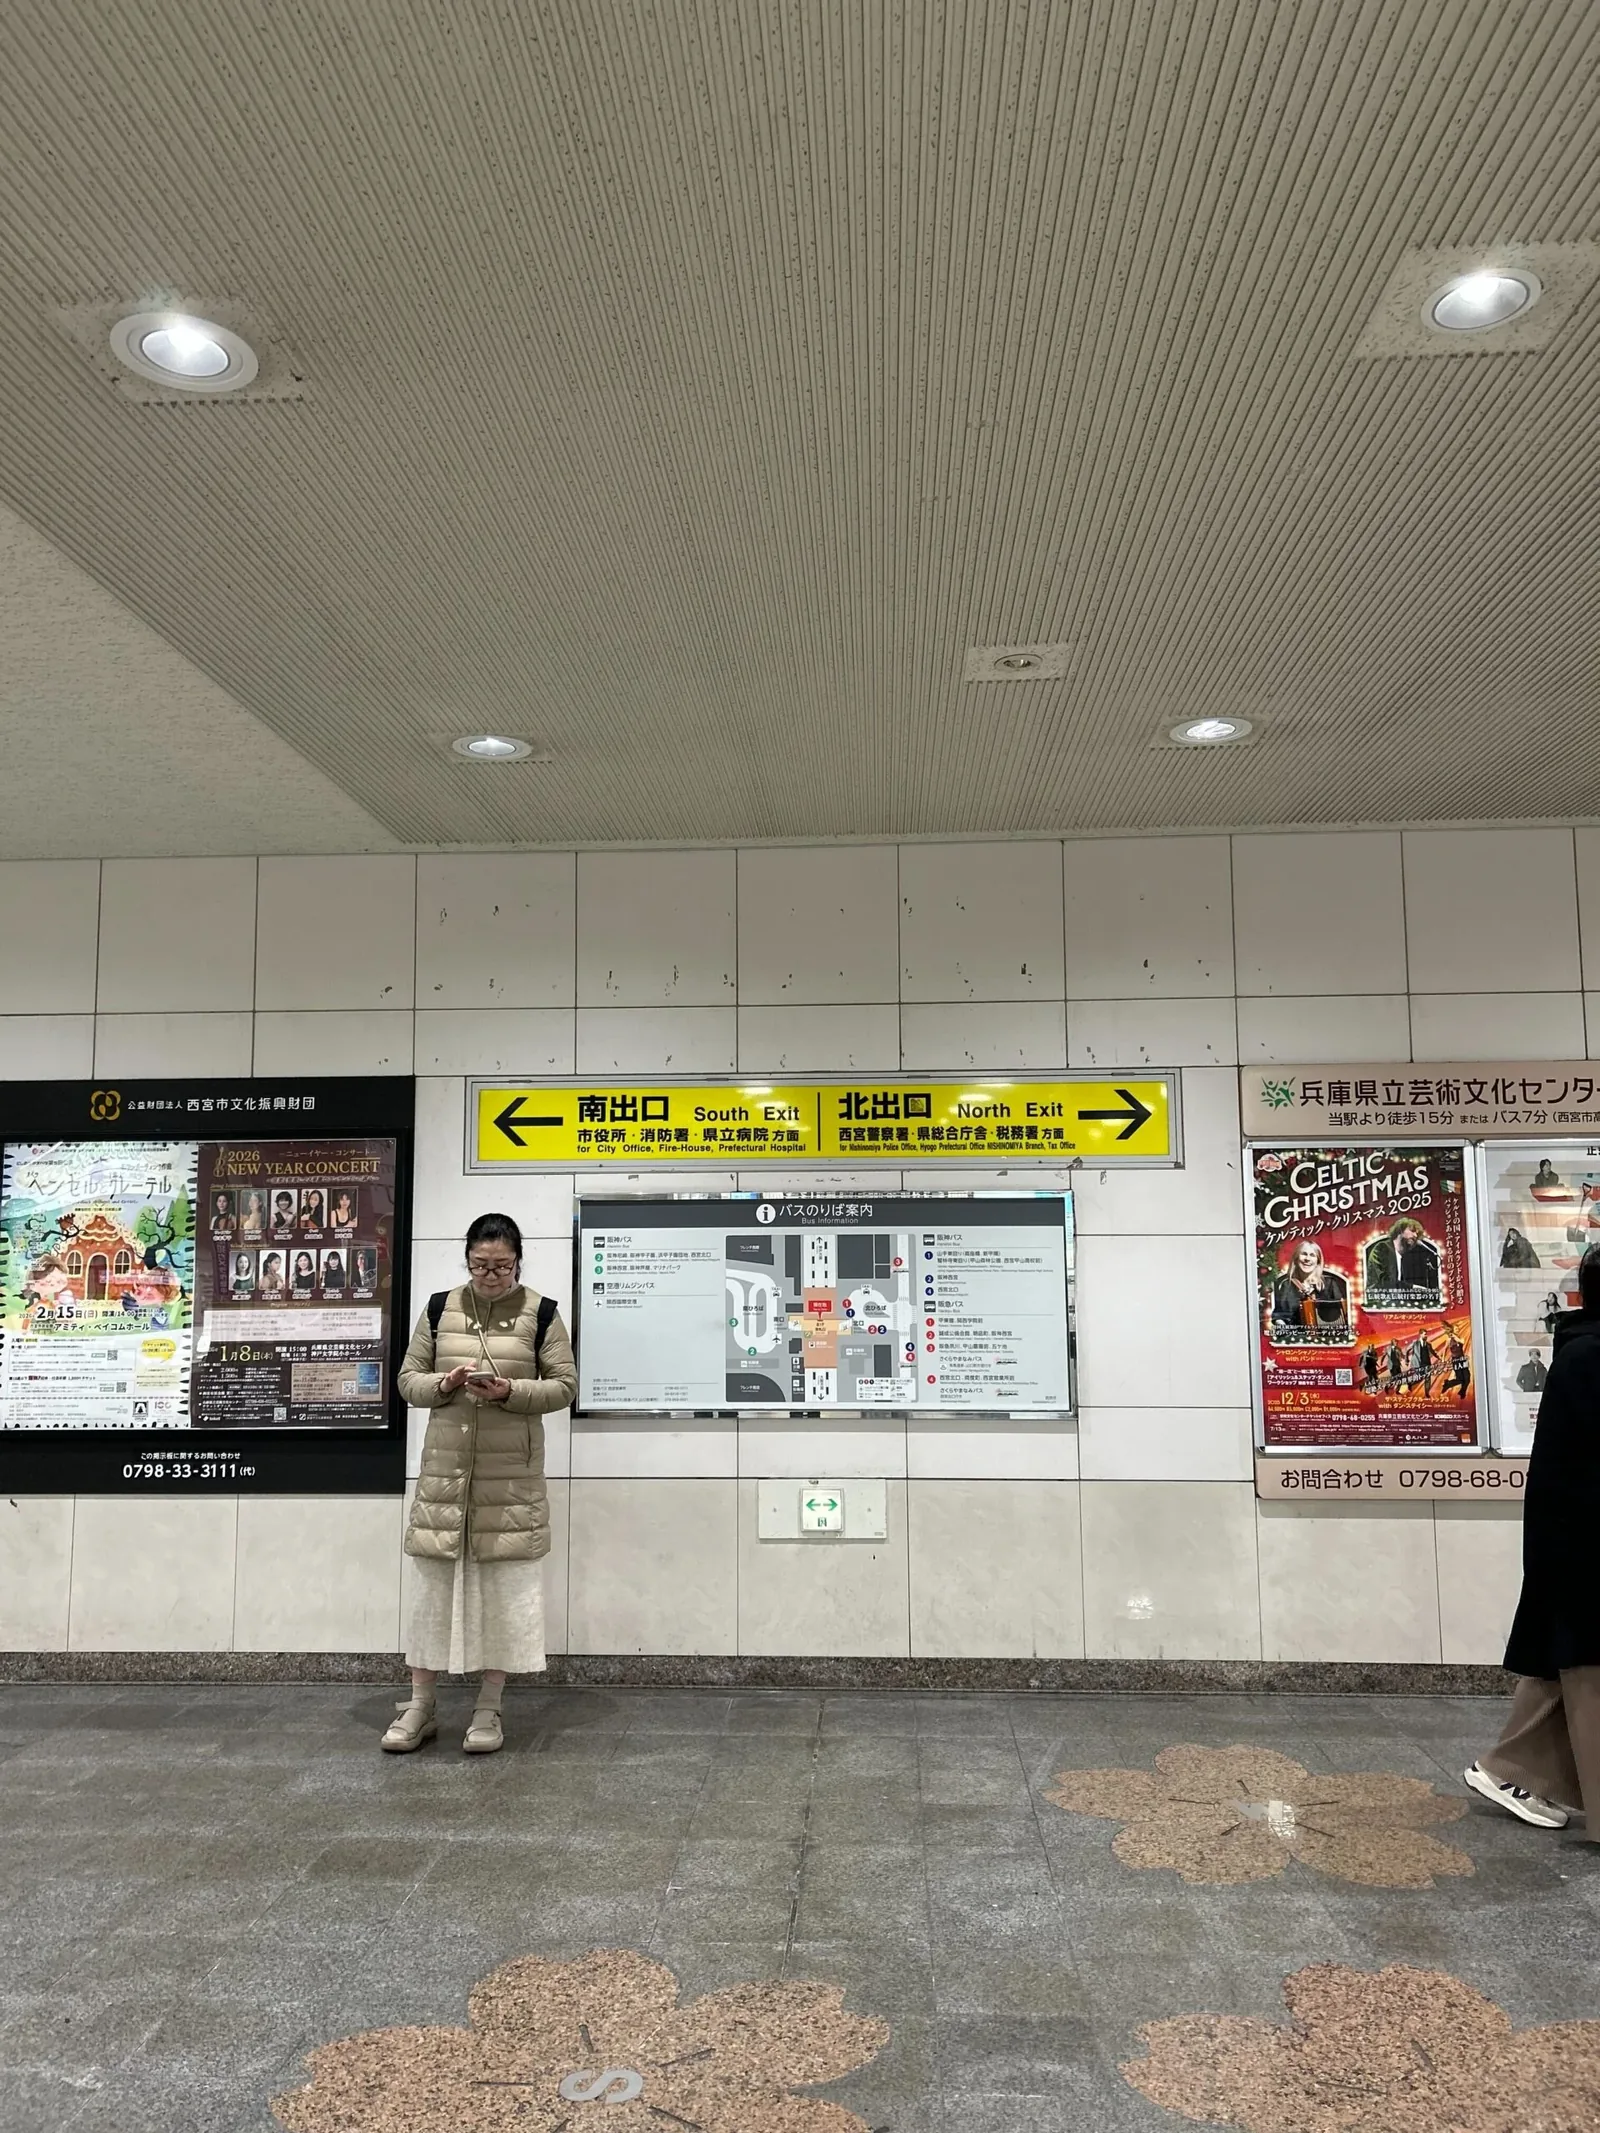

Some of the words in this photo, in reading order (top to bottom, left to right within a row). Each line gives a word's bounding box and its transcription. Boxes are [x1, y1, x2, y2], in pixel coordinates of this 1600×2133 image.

[1300, 1078, 1600, 1107] 兵庫県立芸術文化センタ
[128, 1101, 183, 1110] 公益財団法人
[187, 1096, 316, 1111] 西宮市文化振興財団
[578, 1095, 669, 1122] 南出口
[694, 1107, 749, 1121] South
[764, 1106, 800, 1121] Exit
[839, 1092, 931, 1120] 北出口
[958, 1103, 1010, 1118] North
[1026, 1102, 1063, 1118] Exit
[1328, 1110, 1454, 1126] 当駅より徒歩15分
[1460, 1114, 1489, 1124] または
[1492, 1110, 1546, 1124] バス7分
[578, 1128, 769, 1142] 市役所・消防署・県立病院
[772, 1129, 799, 1141] 方面
[840, 1126, 1038, 1142] 西宮警察署・県総合庁舎・税務署
[1042, 1128, 1064, 1141] 方面
[577, 1145, 590, 1153] for
[598, 1145, 616, 1155] City
[622, 1144, 654, 1155] Office,
[659, 1144, 713, 1155] Fire-House,
[719, 1144, 766, 1153] Prefectural
[770, 1144, 806, 1154] Hospital
[840, 1143, 848, 1151] for
[850, 1143, 881, 1153] Nishinomiya
[883, 1143, 899, 1151] Police
[901, 1143, 918, 1152] Office,
[920, 1143, 937, 1153] Hyogo
[939, 1142, 968, 1151] Prefectural
[970, 1142, 985, 1151] Office
[987, 1142, 1024, 1151] NISHINOMIYA
[1026, 1142, 1046, 1152] Branch,
[1048, 1142, 1058, 1150] Tax
[1060, 1142, 1076, 1150] Office
[228, 1150, 260, 1162] 2026
[226, 1163, 262, 1176] NEW
[265, 1162, 304, 1174] YEAR
[306, 1160, 381, 1174] CONCERT
[1290, 1152, 1385, 1194] CELTIC
[1264, 1165, 1429, 1228] CHRISTMAS
[780, 1204, 873, 1217] バスのりば案内
[1265, 1205, 1386, 1246] ケルティック・クリスマス
[1387, 1190, 1432, 1217] 2025
[54, 1322, 150, 1331] アミティ・ベイコムホール
[220, 1345, 273, 1362] 1月8日(木)
[1282, 1390, 1309, 1406] 12/3
[1332, 1414, 1376, 1422] 0798-68-0255
[140, 1452, 240, 1460] この掲示板に関するお問い合わせ
[123, 1464, 236, 1478] 0798-33-3111
[240, 1466, 256, 1477] (代)
[1280, 1469, 1384, 1490] お問合わせ
[1398, 1469, 1525, 1489] 0798-68-0
